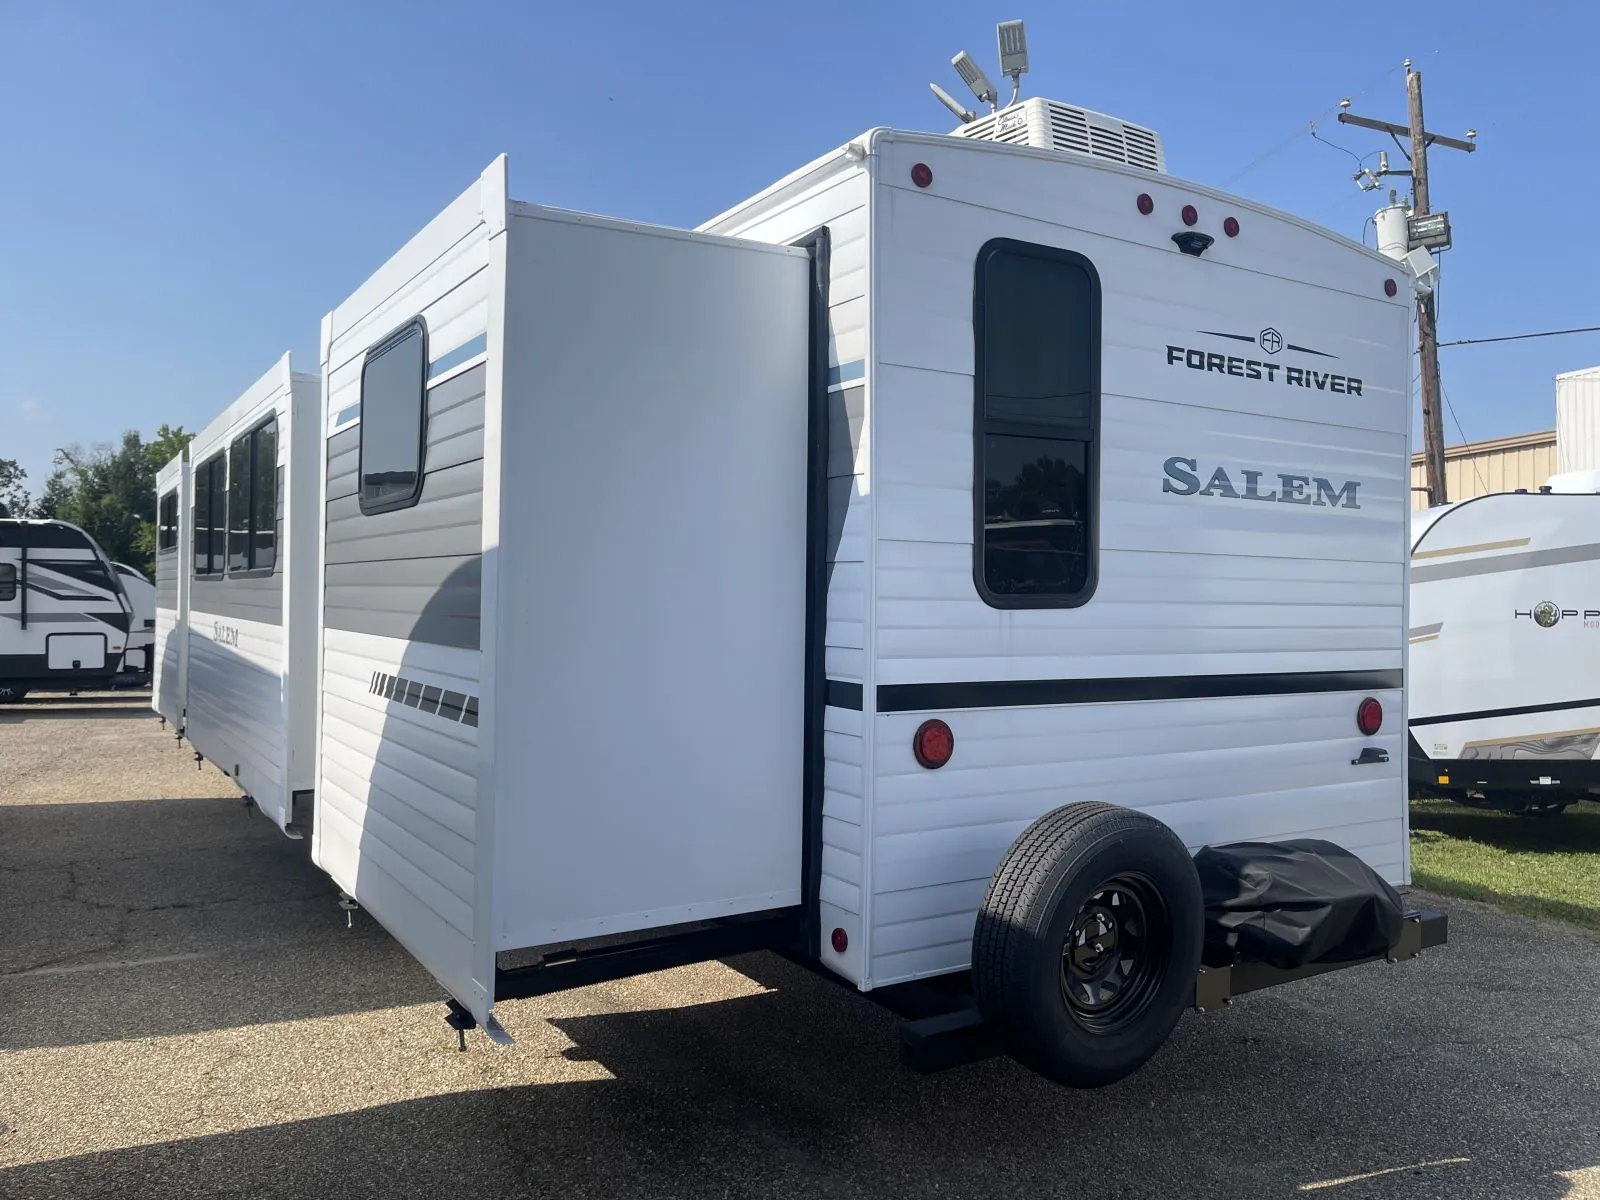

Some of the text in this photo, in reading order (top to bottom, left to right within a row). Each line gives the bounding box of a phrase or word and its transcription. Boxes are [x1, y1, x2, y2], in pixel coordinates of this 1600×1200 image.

[1166, 345, 1363, 396] FOREST RIVER
[1162, 456, 1361, 509] SALEM
